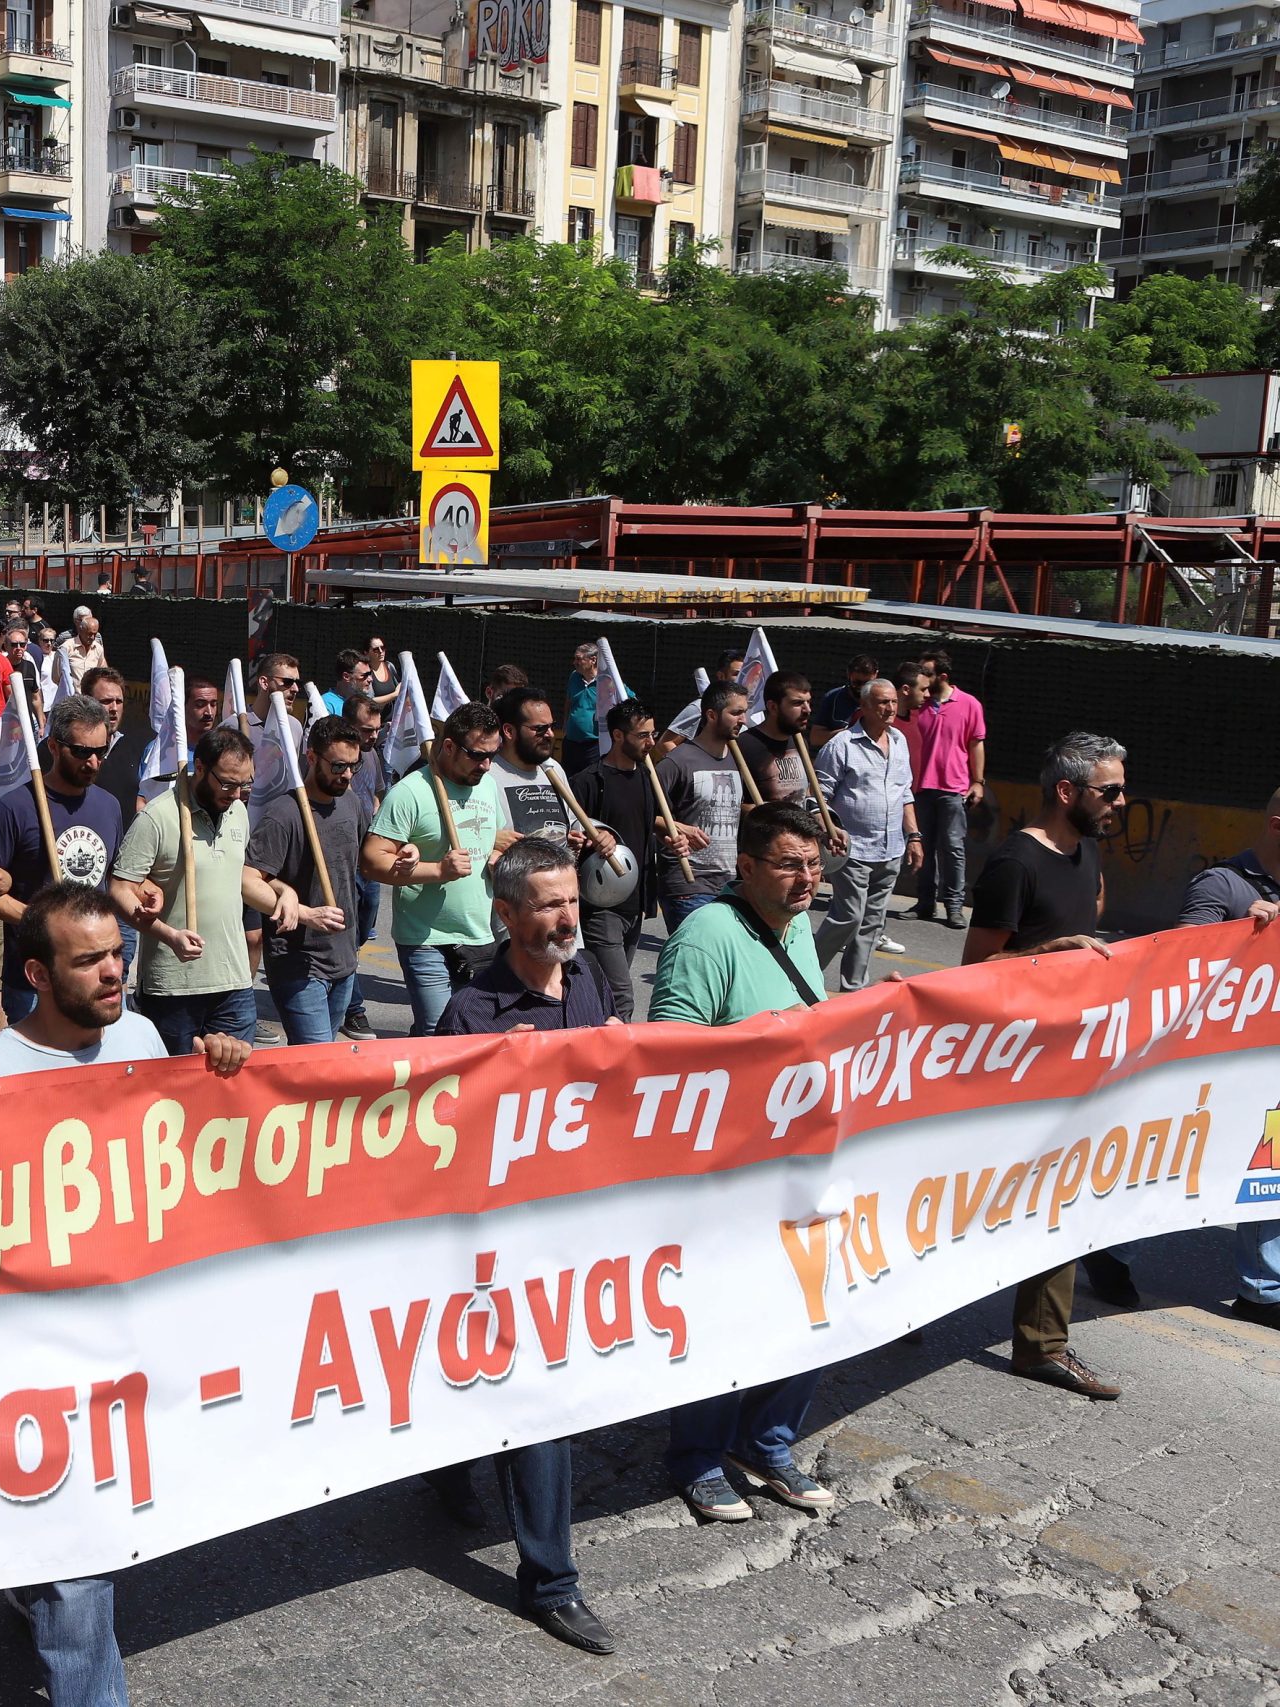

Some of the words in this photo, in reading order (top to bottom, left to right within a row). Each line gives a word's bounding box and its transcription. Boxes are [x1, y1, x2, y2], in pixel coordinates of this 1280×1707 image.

[57, 829, 103, 856] BUDAPEST
[487, 1080, 598, 1187] με
[632, 1068, 731, 1152] τη
[765, 1012, 1045, 1140] φτώχεια,
[1078, 997, 1131, 1070] τη
[291, 1247, 690, 1432] Αγώνας
[778, 1192, 891, 1328] για
[906, 1081, 1212, 1260] ανατροπή
